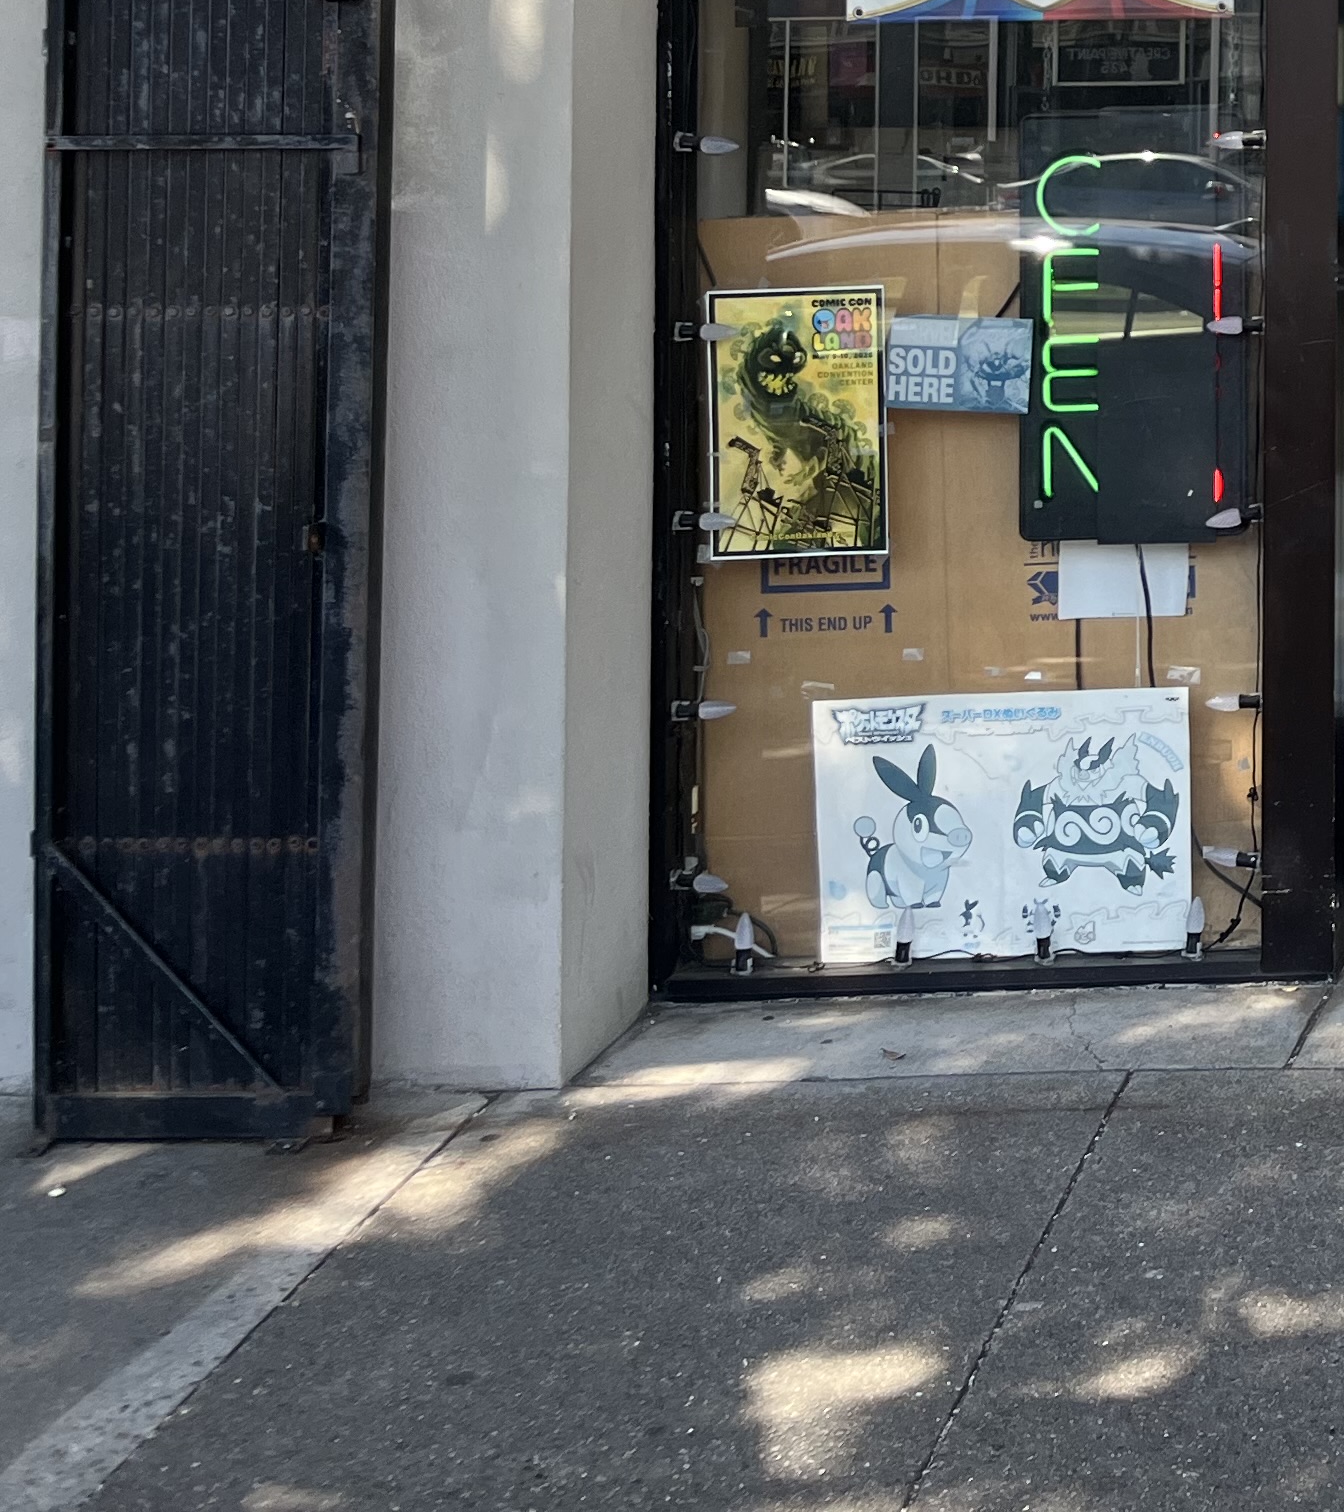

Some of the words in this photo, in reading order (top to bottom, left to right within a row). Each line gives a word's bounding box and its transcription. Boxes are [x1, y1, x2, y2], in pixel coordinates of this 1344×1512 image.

[811, 297, 846, 308] COMIC
[848, 297, 872, 307] CON
[811, 332, 873, 352] LAND
[831, 361, 873, 370] OAKLAND
[889, 347, 957, 377] SOLD
[817, 370, 873, 379] CONVENTION
[839, 378, 873, 386] CENTER
[887, 375, 954, 404] HERE
[773, 554, 877, 576] FRAGILE
[780, 617, 813, 633] THIS
[818, 616, 847, 631] END
[852, 615, 873, 630] UP
